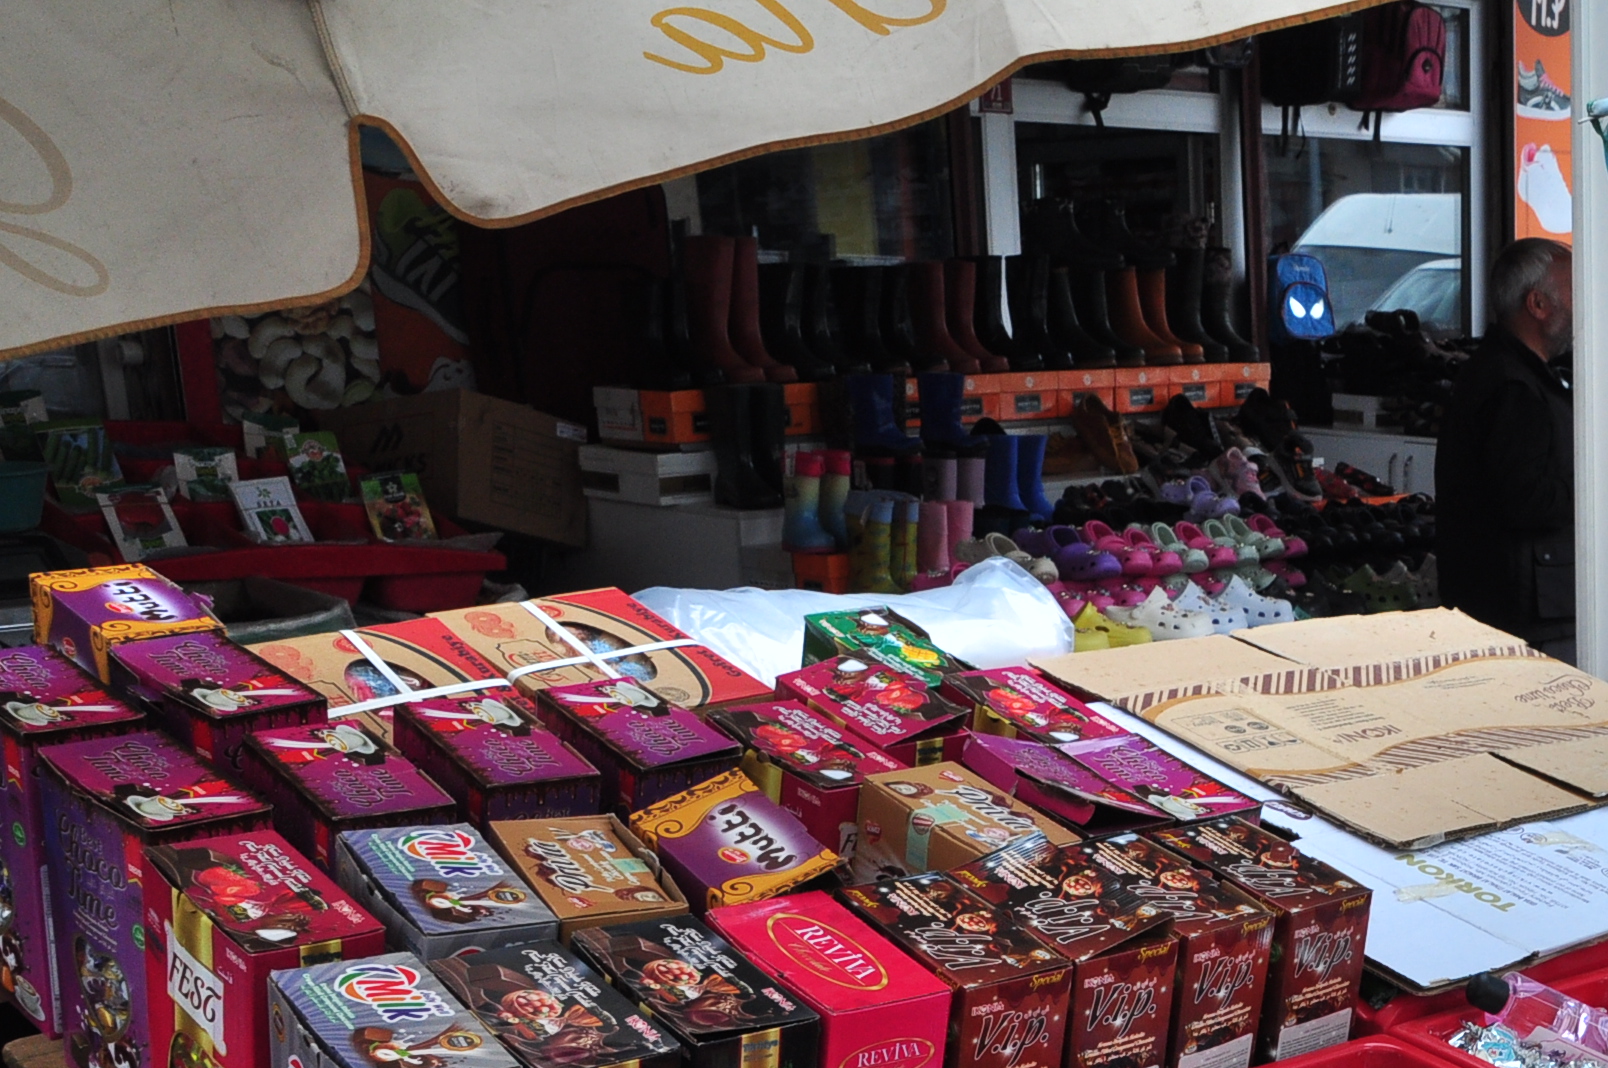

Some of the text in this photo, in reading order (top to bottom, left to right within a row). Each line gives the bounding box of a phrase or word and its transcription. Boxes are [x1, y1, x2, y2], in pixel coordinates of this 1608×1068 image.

[103, 580, 178, 621] Mutti
[626, 602, 686, 640] Kurabiye
[696, 648, 742, 679] Gofret
[113, 741, 170, 782] Choco
[1110, 744, 1170, 784] Choco
[57, 811, 128, 893] Choco
[708, 802, 798, 872] Mutti
[417, 840, 484, 876] Milk
[64, 855, 120, 931] Time
[1393, 853, 1517, 912] TORKON
[1340, 895, 1368, 912] Special
[1241, 917, 1270, 936] Special
[1138, 945, 1171, 965] Special
[169, 951, 221, 1023] FEST
[354, 979, 432, 1022] Milk
[1029, 970, 1065, 991] Special
